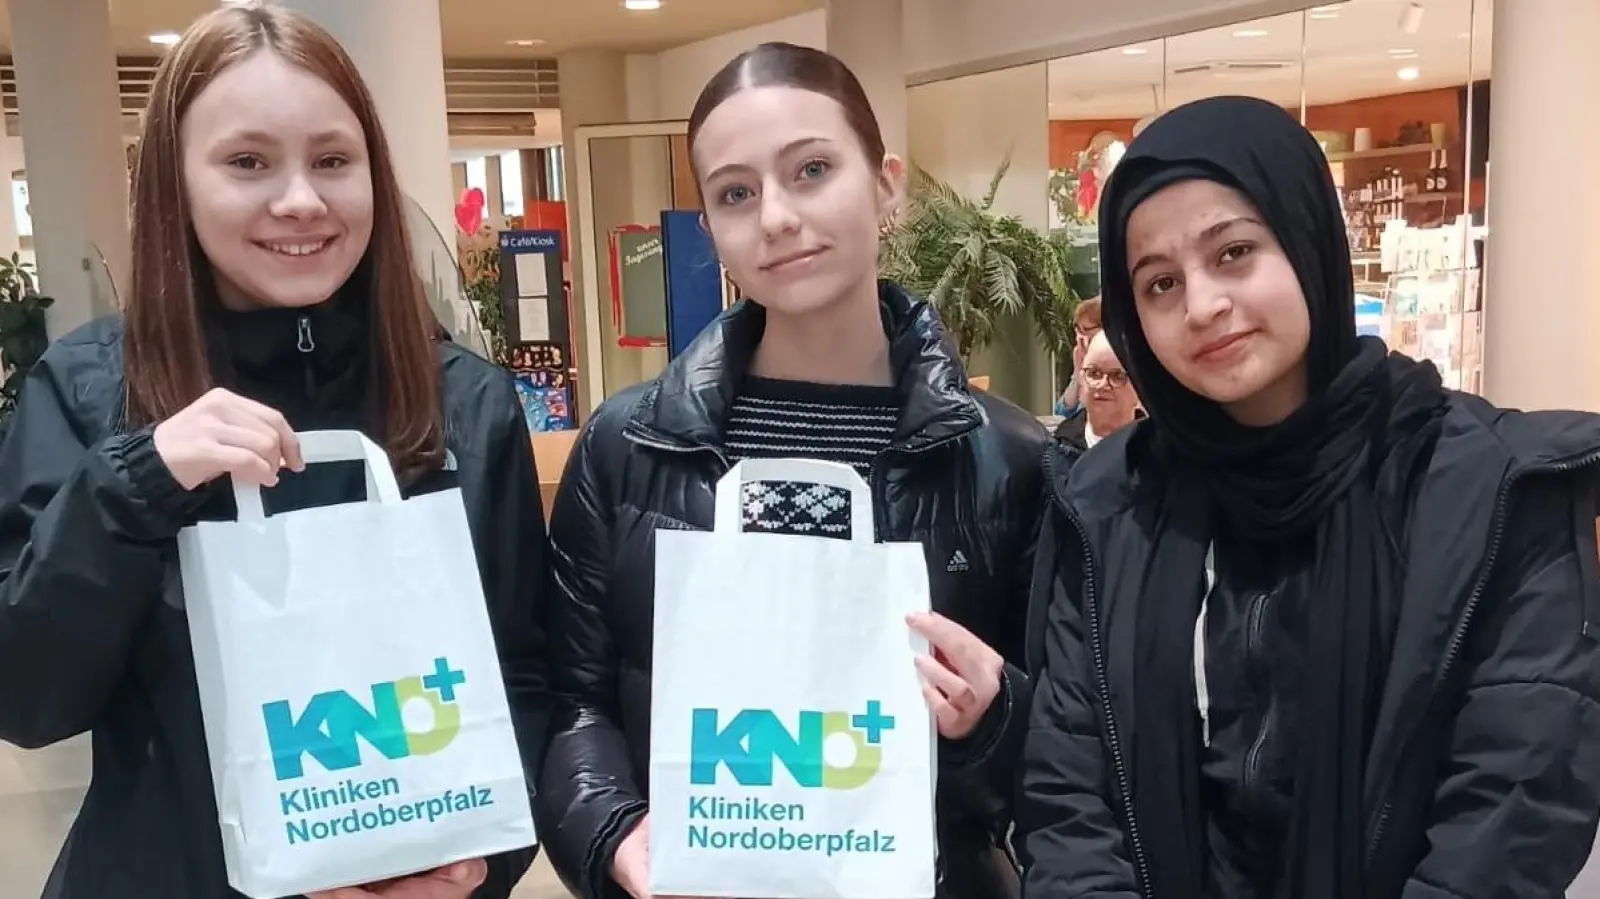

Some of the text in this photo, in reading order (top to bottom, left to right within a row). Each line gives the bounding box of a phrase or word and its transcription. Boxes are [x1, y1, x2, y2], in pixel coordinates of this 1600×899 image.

[280, 775, 400, 816] Kliniken
[689, 795, 805, 821] Kliniken
[286, 784, 494, 845] Nordoberpfalz
[688, 824, 896, 857] Nordoberpfalz
